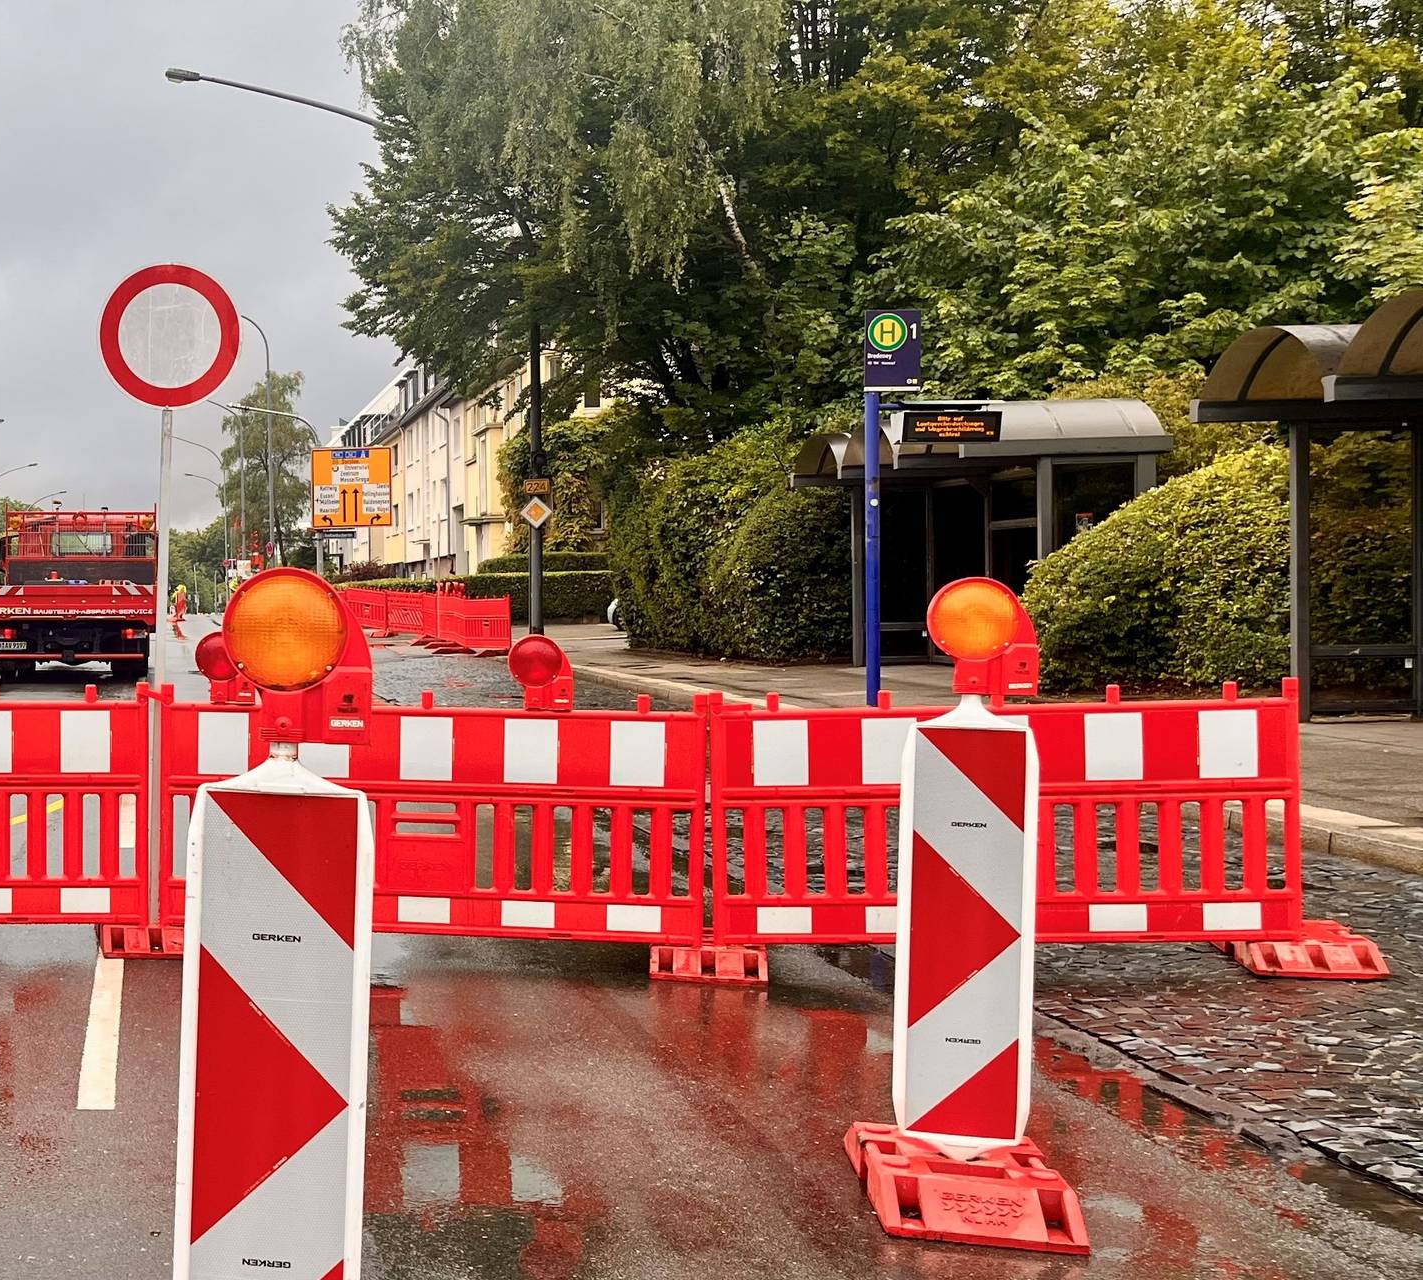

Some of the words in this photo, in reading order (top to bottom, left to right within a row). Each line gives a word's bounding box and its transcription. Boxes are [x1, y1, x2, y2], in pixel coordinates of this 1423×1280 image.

[880, 322, 896, 343] H
[910, 323, 917, 339] 1
[527, 482, 546, 491] 224
[252, 933, 301, 943] GERKEN
[939, 1191, 1024, 1207] GERKEN
[242, 1258, 291, 1269] GERKEN
